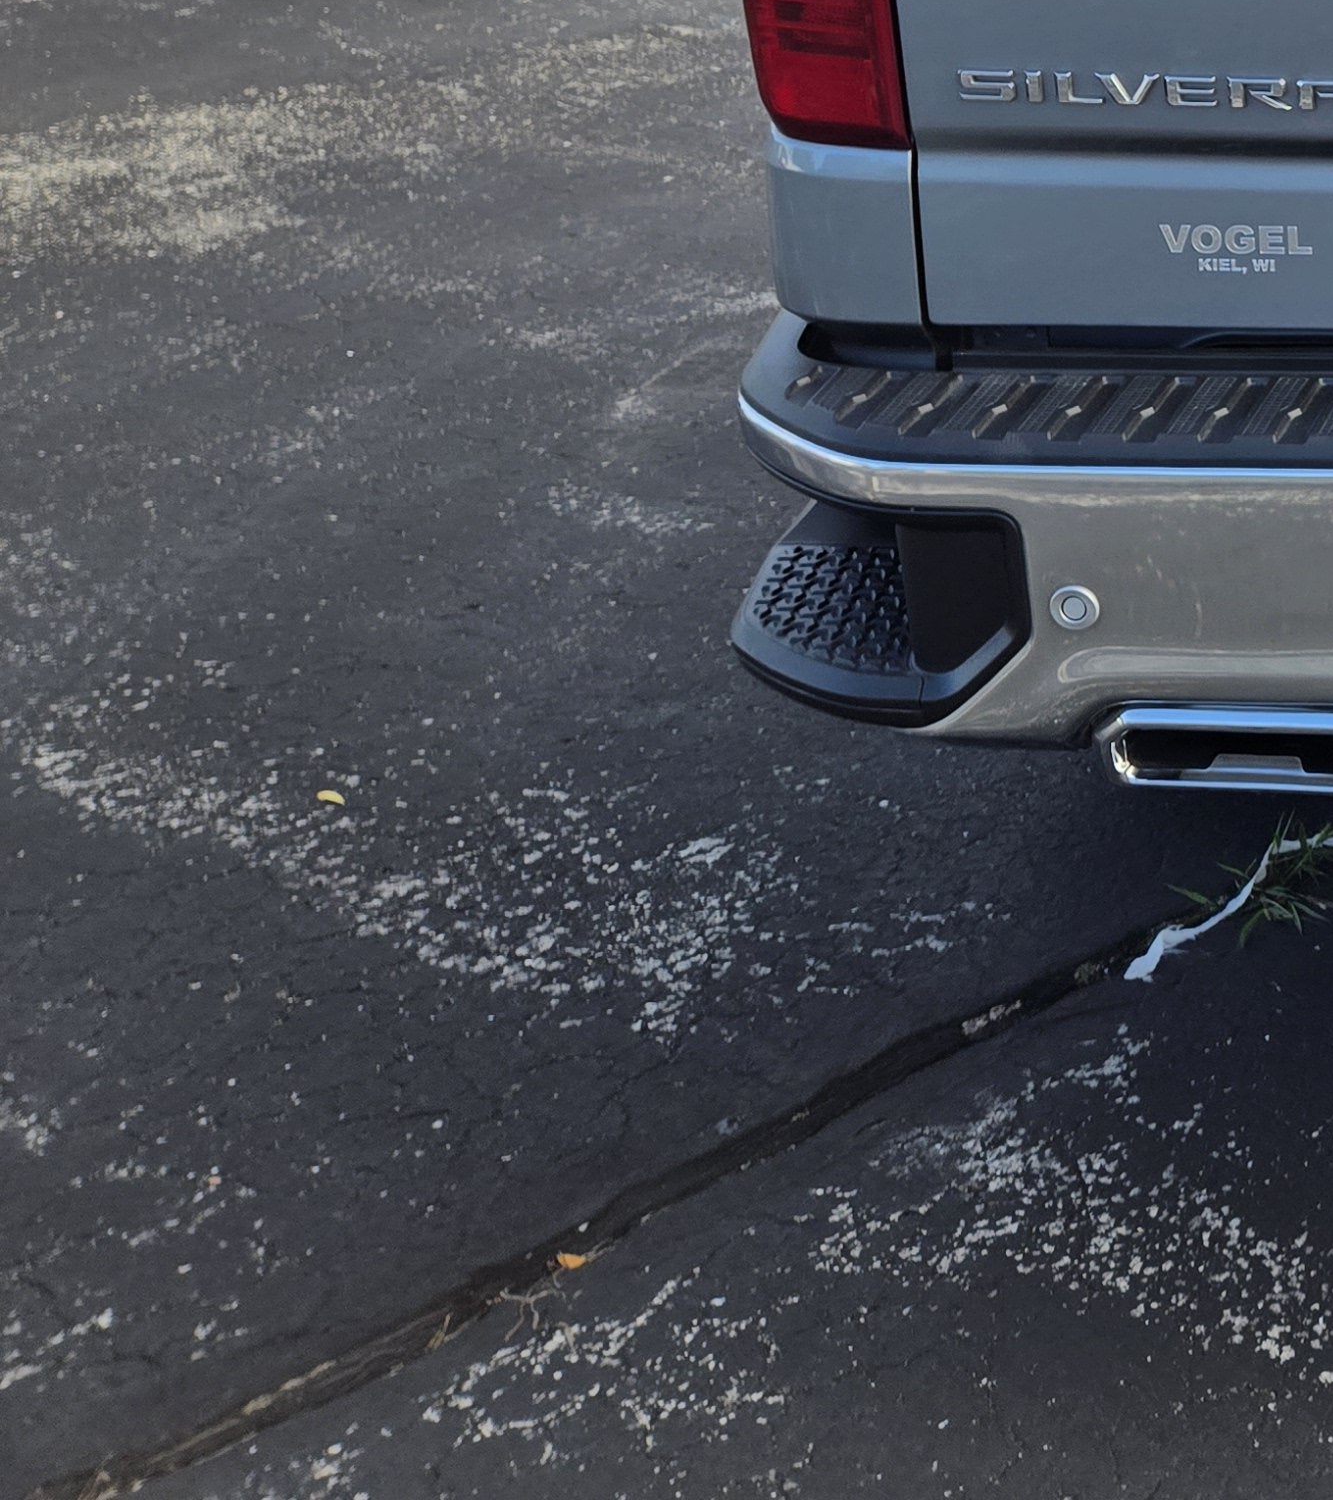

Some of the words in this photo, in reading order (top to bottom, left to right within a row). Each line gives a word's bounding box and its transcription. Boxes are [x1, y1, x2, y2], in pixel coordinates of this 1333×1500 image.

[1158, 223, 1313, 255] VOGEL
[1198, 258, 1248, 274] KIEL,
[1252, 259, 1276, 272] WI
